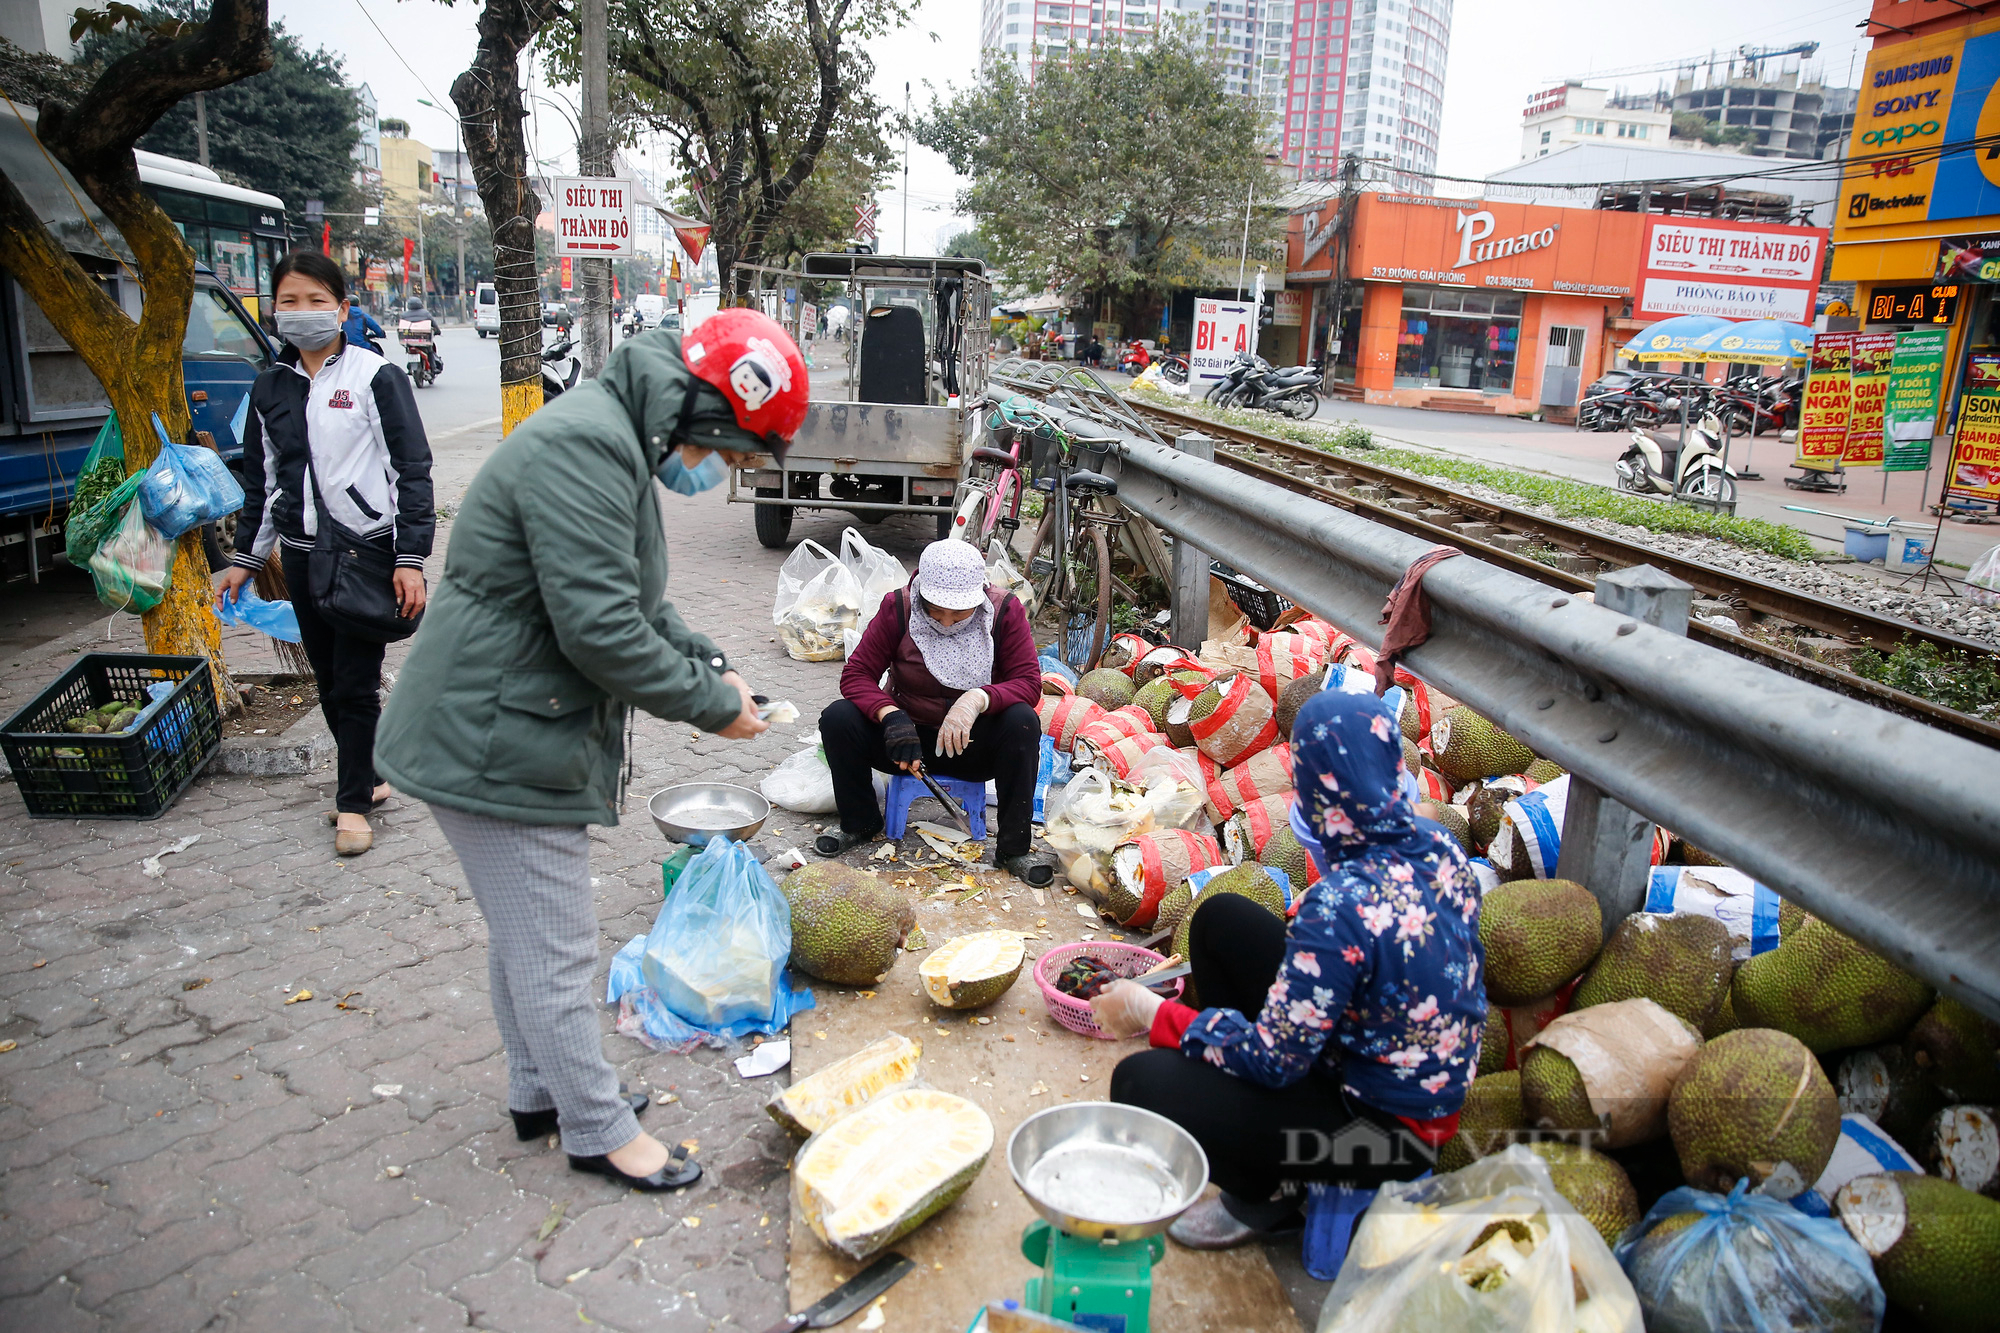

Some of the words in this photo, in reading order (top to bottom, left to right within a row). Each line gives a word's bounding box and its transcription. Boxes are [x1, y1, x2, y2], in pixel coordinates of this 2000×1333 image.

[1873, 55, 1953, 88] SAMSUNG
[1872, 89, 1941, 117] SONY
[1870, 156, 1915, 179] TCL
[566, 184, 596, 207] SIÊU
[600, 189, 622, 213] THỊ
[1869, 193, 1926, 211] Electrolux
[561, 213, 607, 237] THÀNH
[611, 215, 628, 238] ĐÔ
[1452, 208, 1554, 269] Punaco
[1656, 229, 1694, 254] SIÊU
[1698, 237, 1726, 262] THỊ
[1788, 239, 1811, 263] ĐÔ
[1371, 266, 1387, 278] 352
[1980, 261, 2000, 280] GI
[1676, 285, 1723, 301] PHÒNG
[1727, 286, 1756, 303] BẢO
[1931, 285, 1958, 298] CLUB
[1200, 303, 1217, 315] CLUB
[1647, 301, 1664, 311] KHU
[1196, 320, 1216, 351] BI
[1234, 323, 1247, 352] A
[1900, 336, 1940, 345] Kangaroo
[1743, 342, 1781, 351] XANH
[1192, 357, 1207, 368] 352
[1207, 357, 1223, 369] Giải
[1806, 395, 1851, 409] NGAY
[1895, 388, 1932, 399] TRONG
[1969, 397, 2000, 413] SON
[1959, 413, 1992, 423] Android
[1957, 427, 1987, 444] GIẢM
[1974, 446, 2000, 465] TRIỆ
